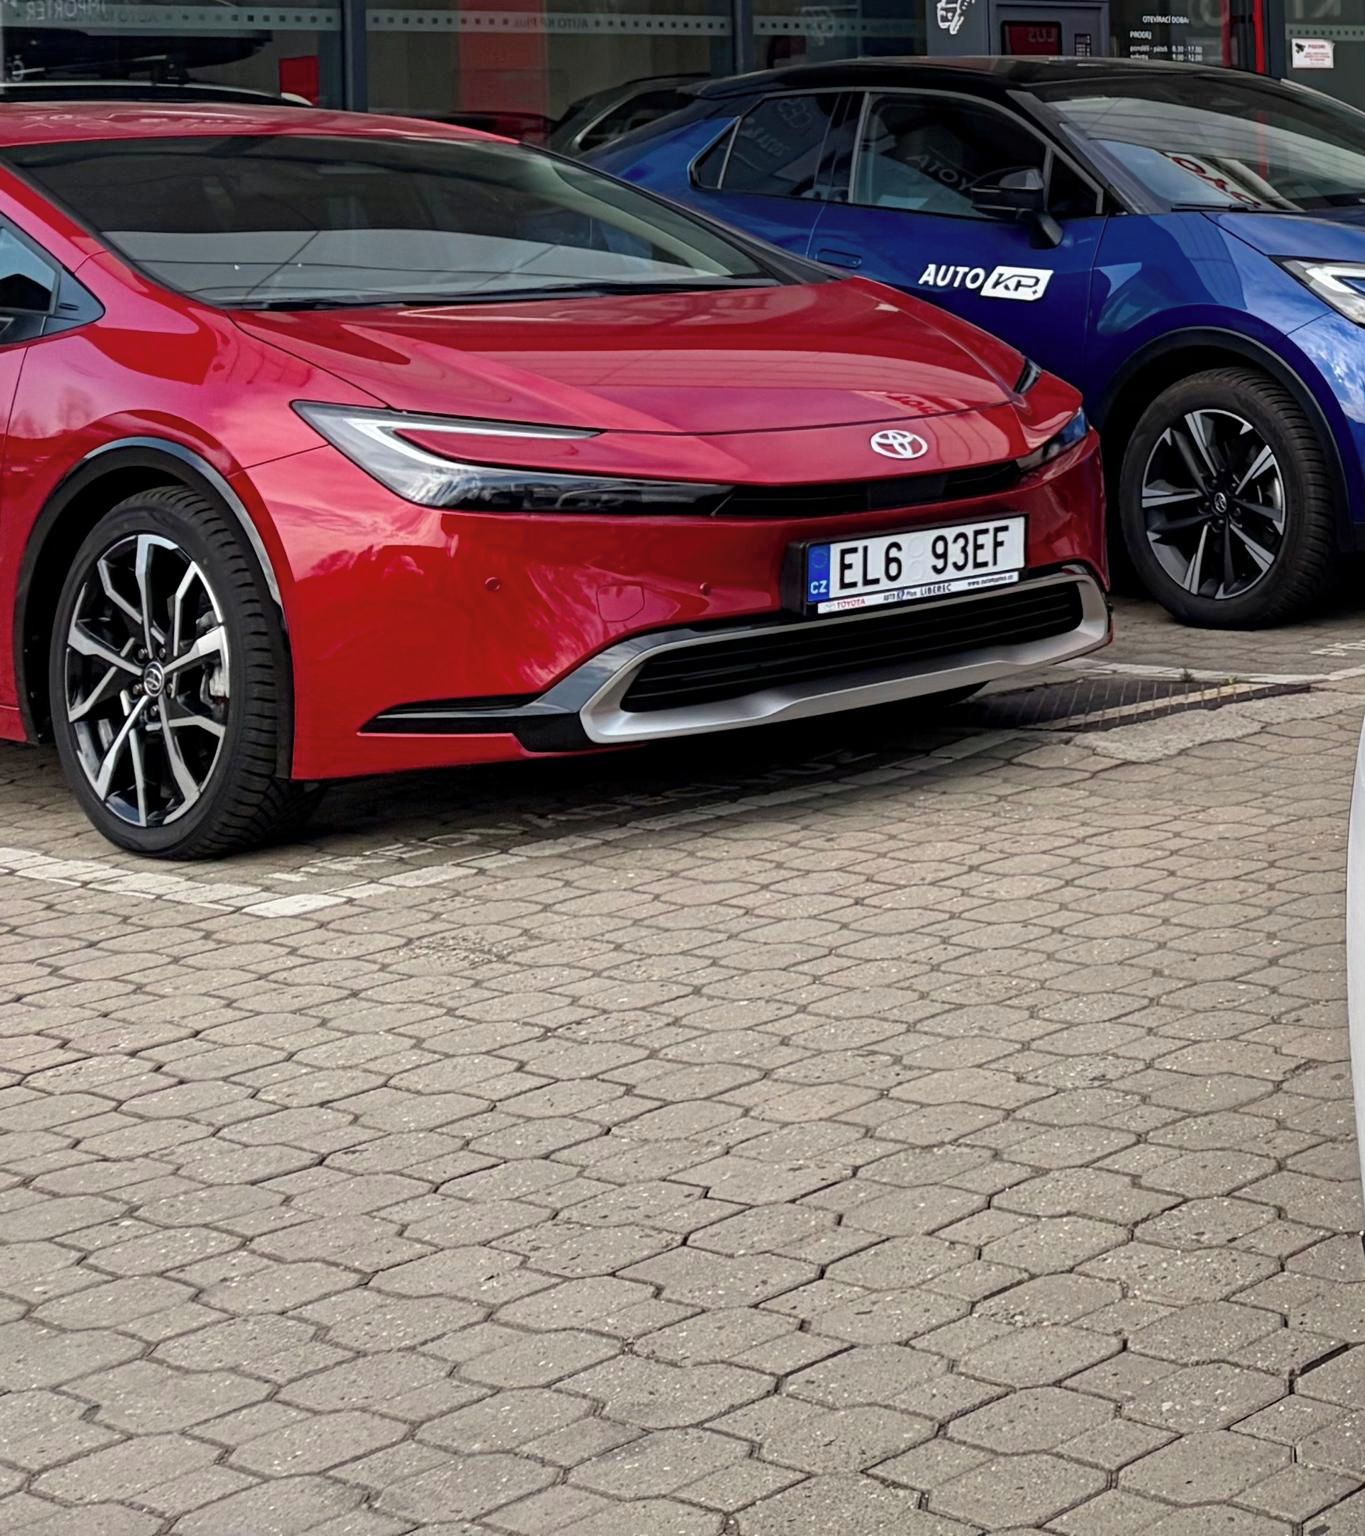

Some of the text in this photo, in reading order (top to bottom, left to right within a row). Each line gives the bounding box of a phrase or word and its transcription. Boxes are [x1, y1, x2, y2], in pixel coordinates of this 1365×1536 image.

[918, 263, 985, 289] AUTO
[810, 524, 1010, 595] CZ EL6 93EF
